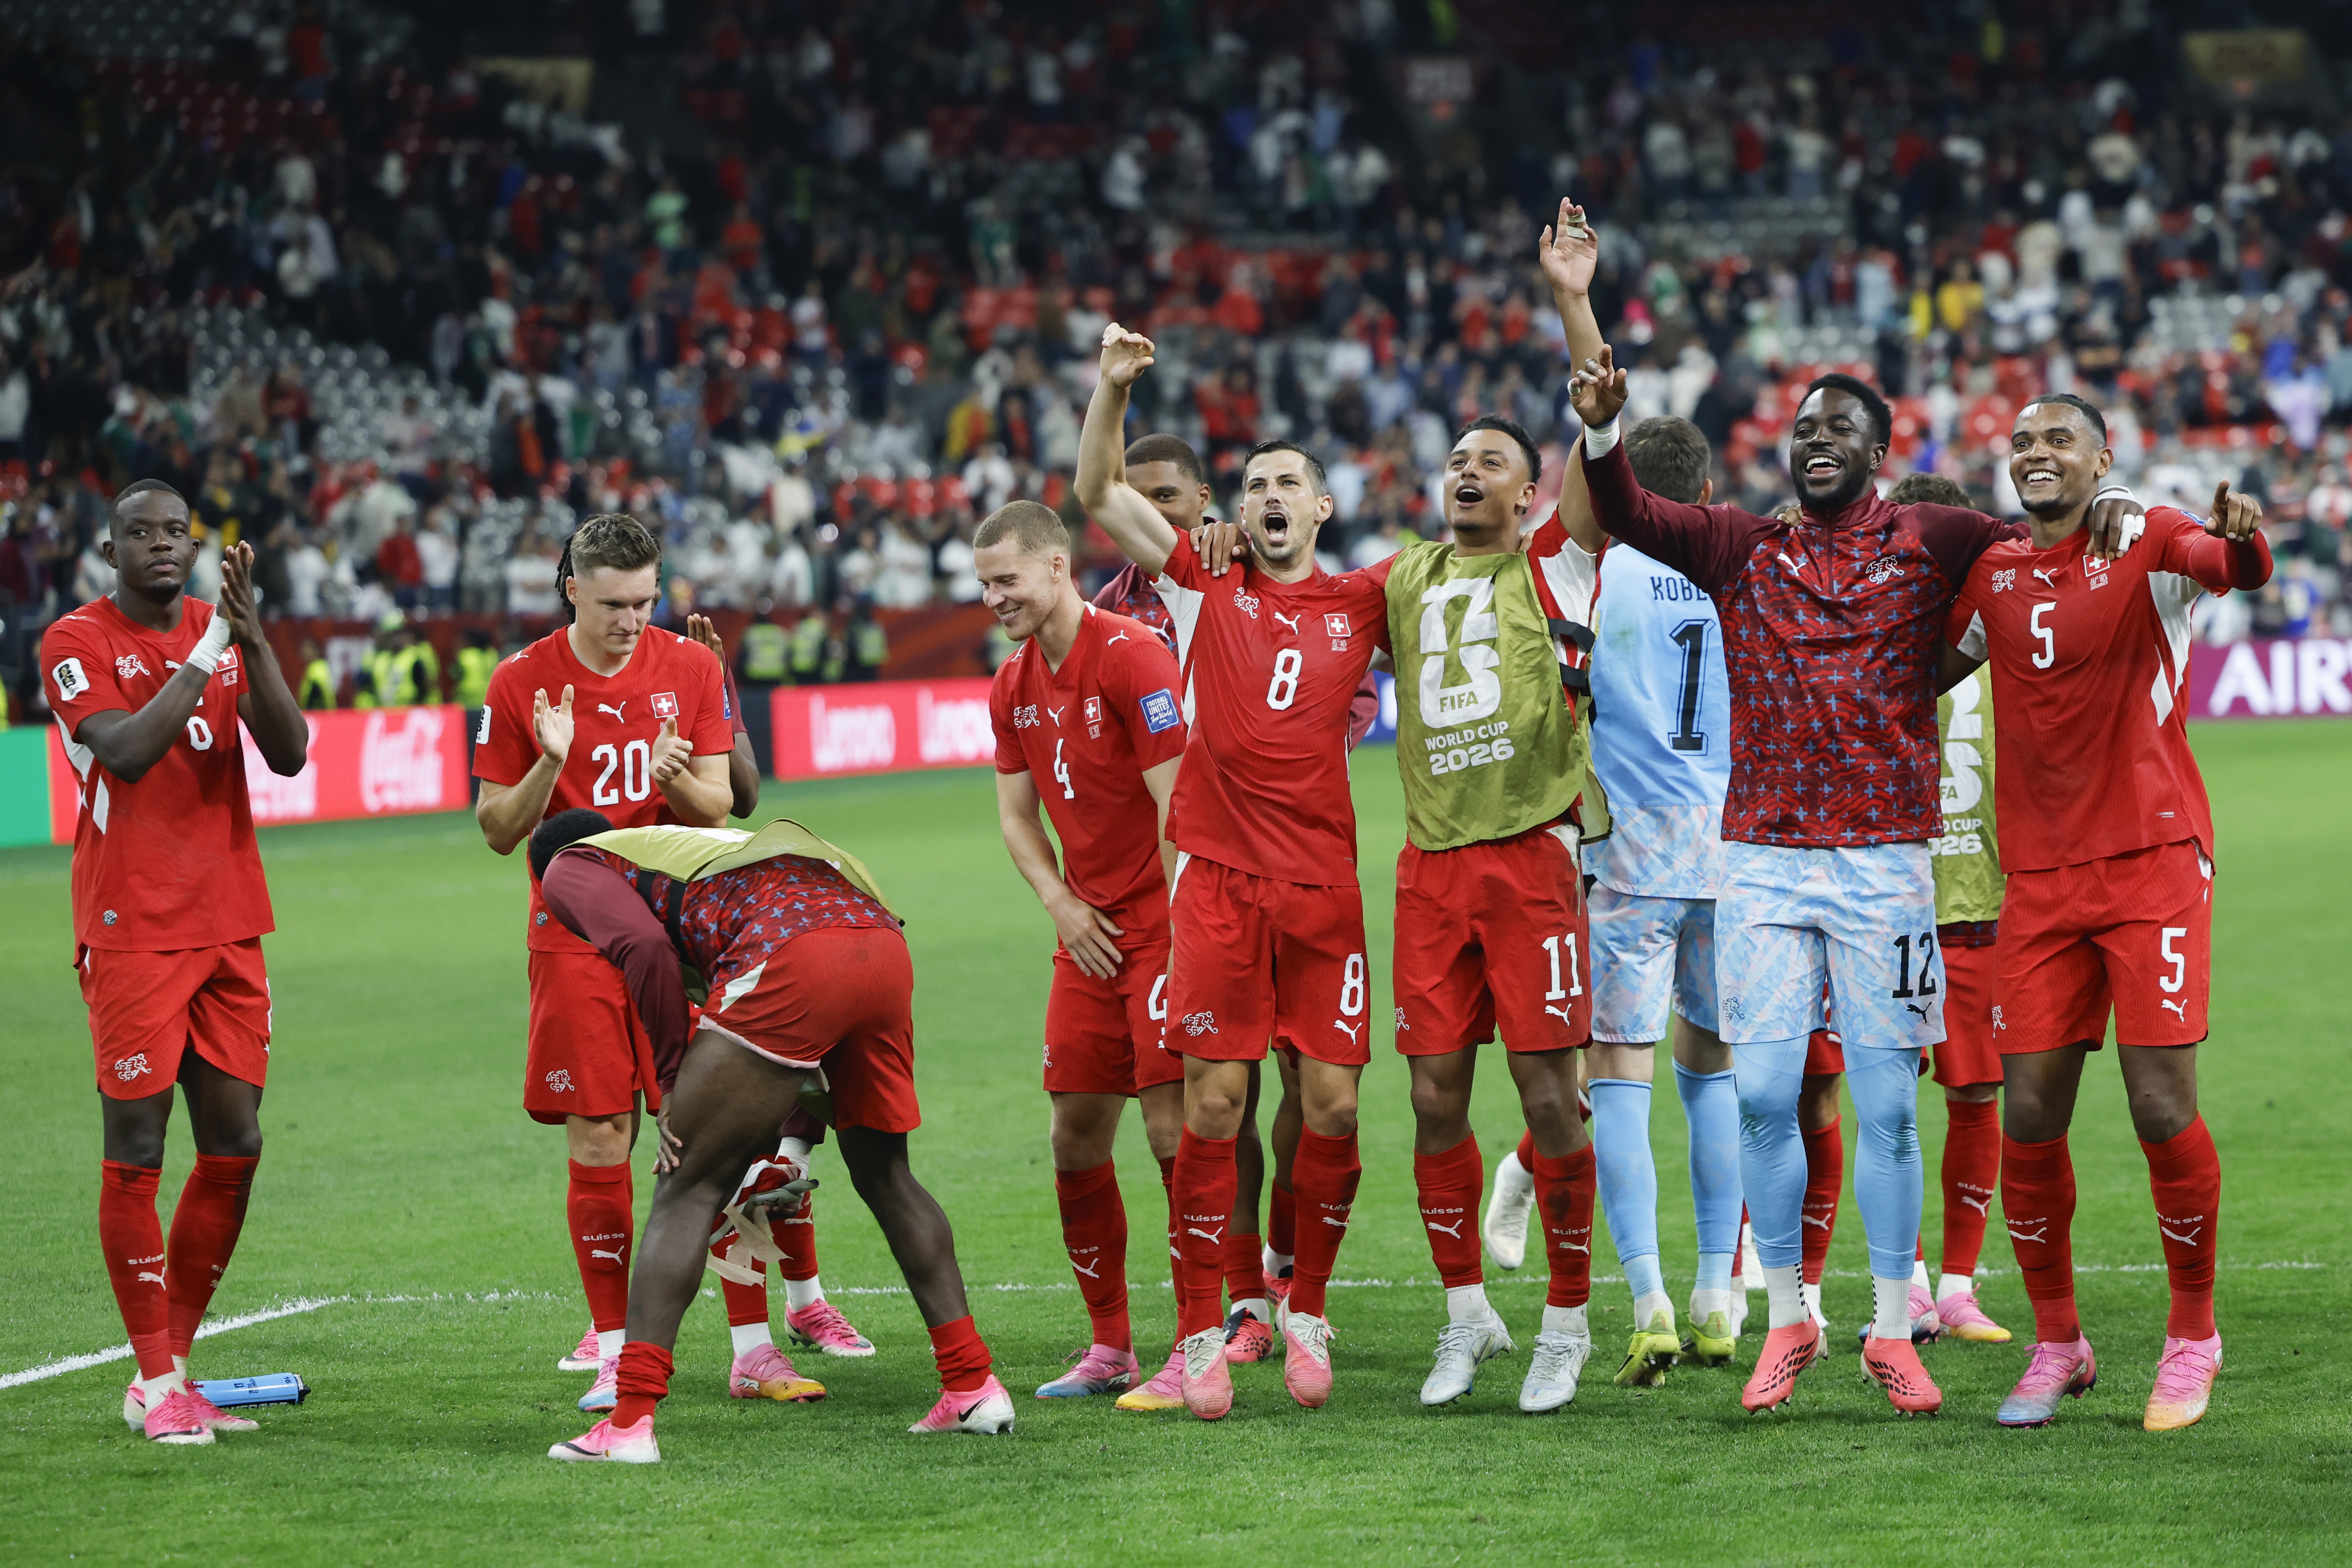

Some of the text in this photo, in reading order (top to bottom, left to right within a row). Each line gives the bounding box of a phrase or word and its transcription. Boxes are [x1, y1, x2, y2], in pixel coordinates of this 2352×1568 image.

[2031, 602, 2057, 669] 5
[1146, 695, 1168, 708] FOOTBALL
[1267, 648, 1303, 710] 8
[1440, 691, 1479, 712] FIFA
[1668, 619, 1716, 756] 1
[2208, 639, 2352, 716] AIR
[1148, 701, 1170, 715] UNITES
[1159, 708, 1173, 719] World
[1424, 721, 1509, 751] WORLD CUP
[1429, 738, 1515, 775] 2026
[592, 739, 651, 806] 20
[1054, 739, 1074, 799] 4
[1939, 786, 1958, 800] FA
[1928, 833, 1983, 856] 026
[1951, 818, 1983, 831] CUP
[1542, 932, 1583, 1001] 11
[1892, 932, 1937, 999] 12
[2159, 927, 2187, 992] 5
[1340, 953, 1364, 1016] 8
[582, 1233, 625, 1242] suisse
